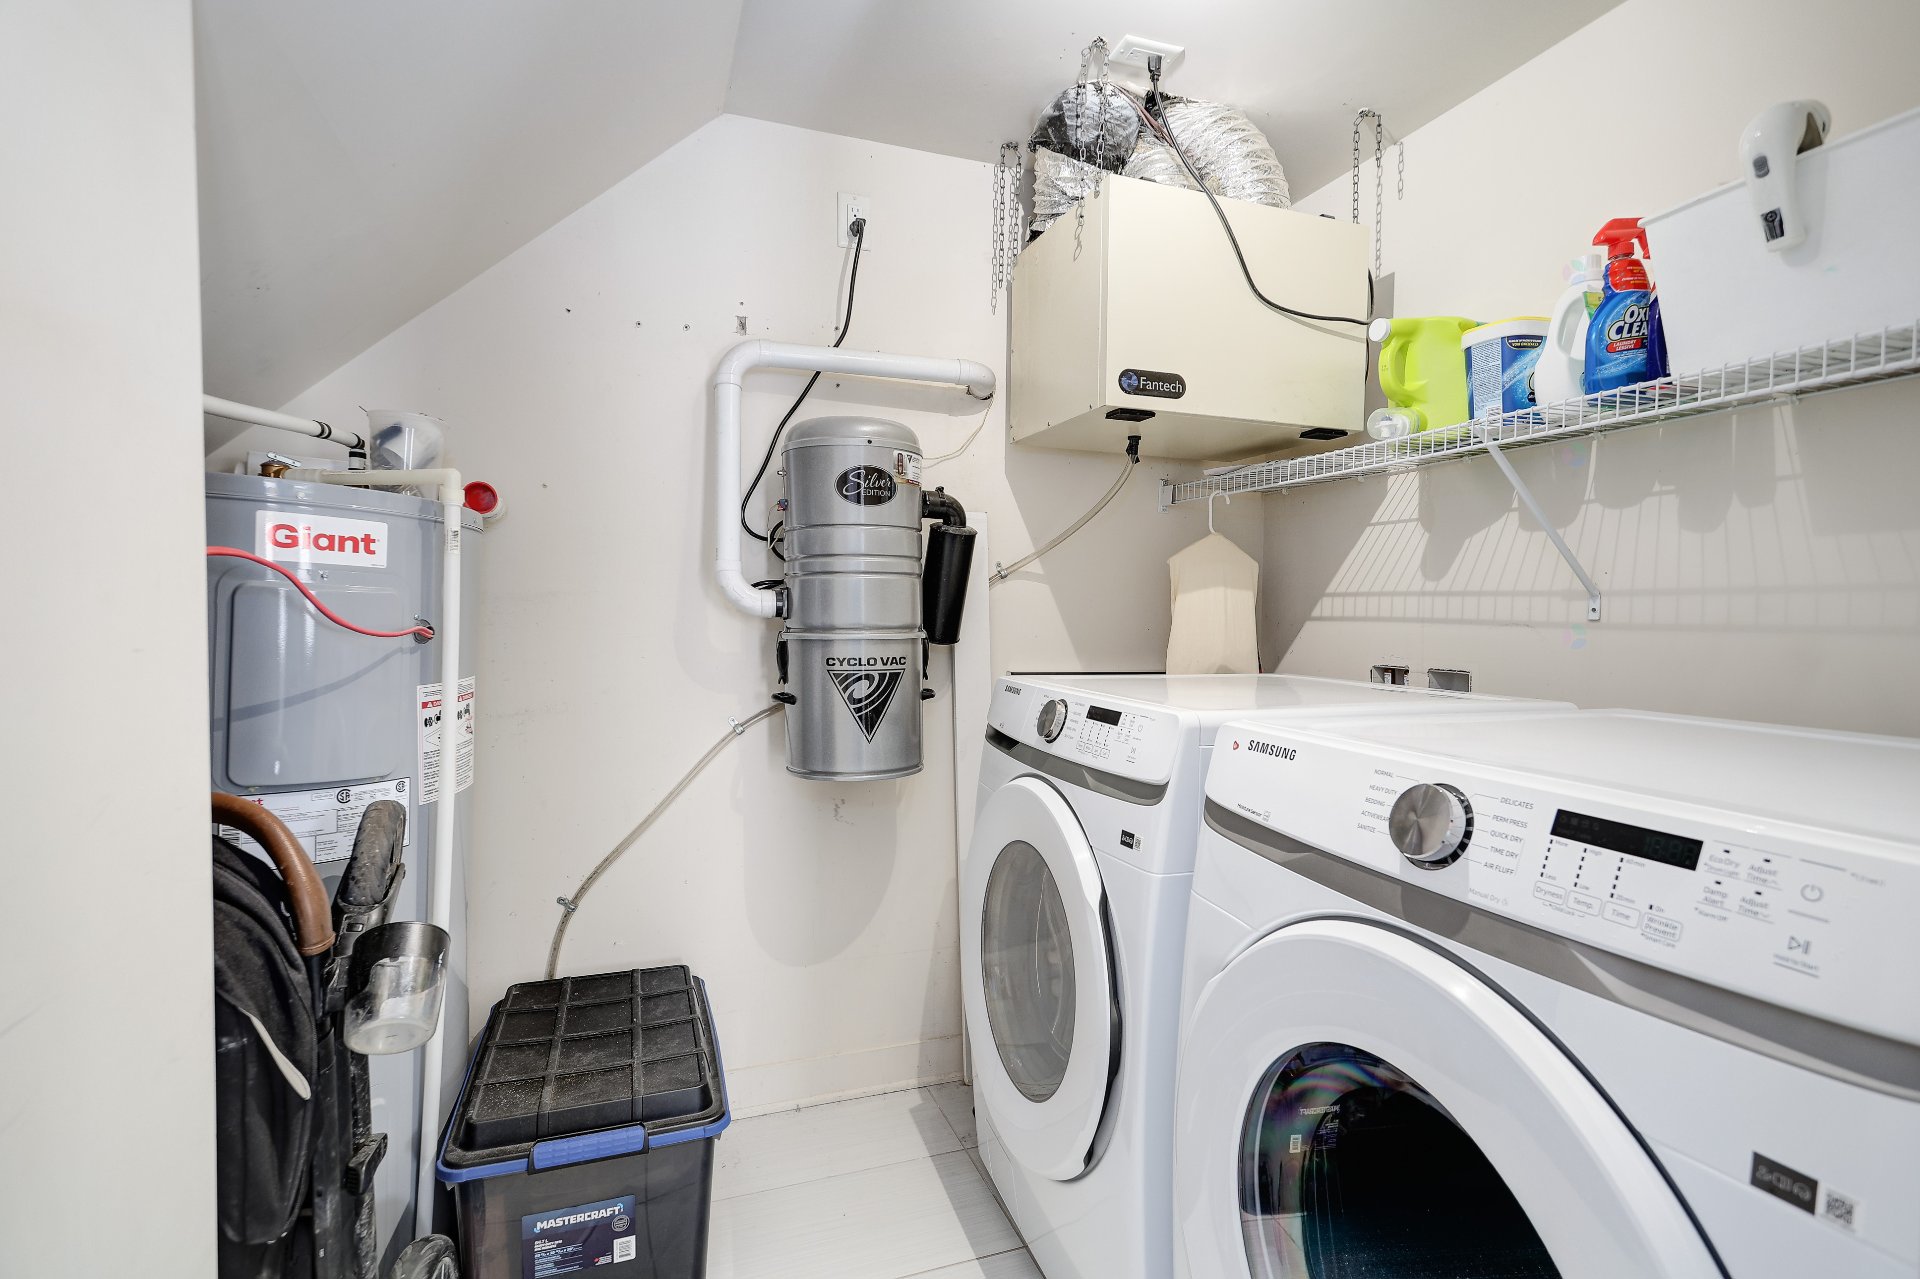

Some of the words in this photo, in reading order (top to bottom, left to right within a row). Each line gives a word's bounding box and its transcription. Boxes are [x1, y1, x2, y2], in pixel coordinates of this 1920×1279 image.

[1140, 377, 1183, 393] Fantech
[842, 469, 891, 495] Silver
[861, 489, 891, 497] EDITION
[268, 523, 376, 556] Giant
[825, 657, 878, 667] CYCLO
[880, 656, 907, 666] VAC
[1247, 740, 1297, 761] SAMSUNG
[1374, 769, 1394, 778] NORMAL
[1369, 784, 1384, 792] HEAVY
[1385, 788, 1398, 796] DUTY
[1365, 797, 1386, 807] BEDDING
[1500, 797, 1534, 810] DELICATES
[1357, 823, 1377, 834] SANITIZE
[1492, 815, 1509, 824] PERM
[1509, 819, 1528, 829] PRESS
[1490, 830, 1509, 840] QUICK
[1510, 834, 1524, 843] DRY
[1490, 846, 1504, 855] TIME
[1505, 850, 1519, 860] DRY
[1484, 862, 1494, 870] AIR
[1495, 865, 1515, 875] FLUFF
[1748, 864, 1778, 876] Adjust
[1747, 873, 1768, 883] Time
[1469, 888, 1489, 899] Manual
[1535, 886, 1564, 901] Dryness
[1703, 886, 1728, 898] Damp
[1739, 896, 1769, 909] Adjust
[1611, 908, 1631, 921] Time
[1739, 904, 1760, 915] Time
[1646, 916, 1678, 931] Wrinkle
[1644, 923, 1677, 939] Prevent
[535, 1204, 622, 1231] MASTERCRAFT
